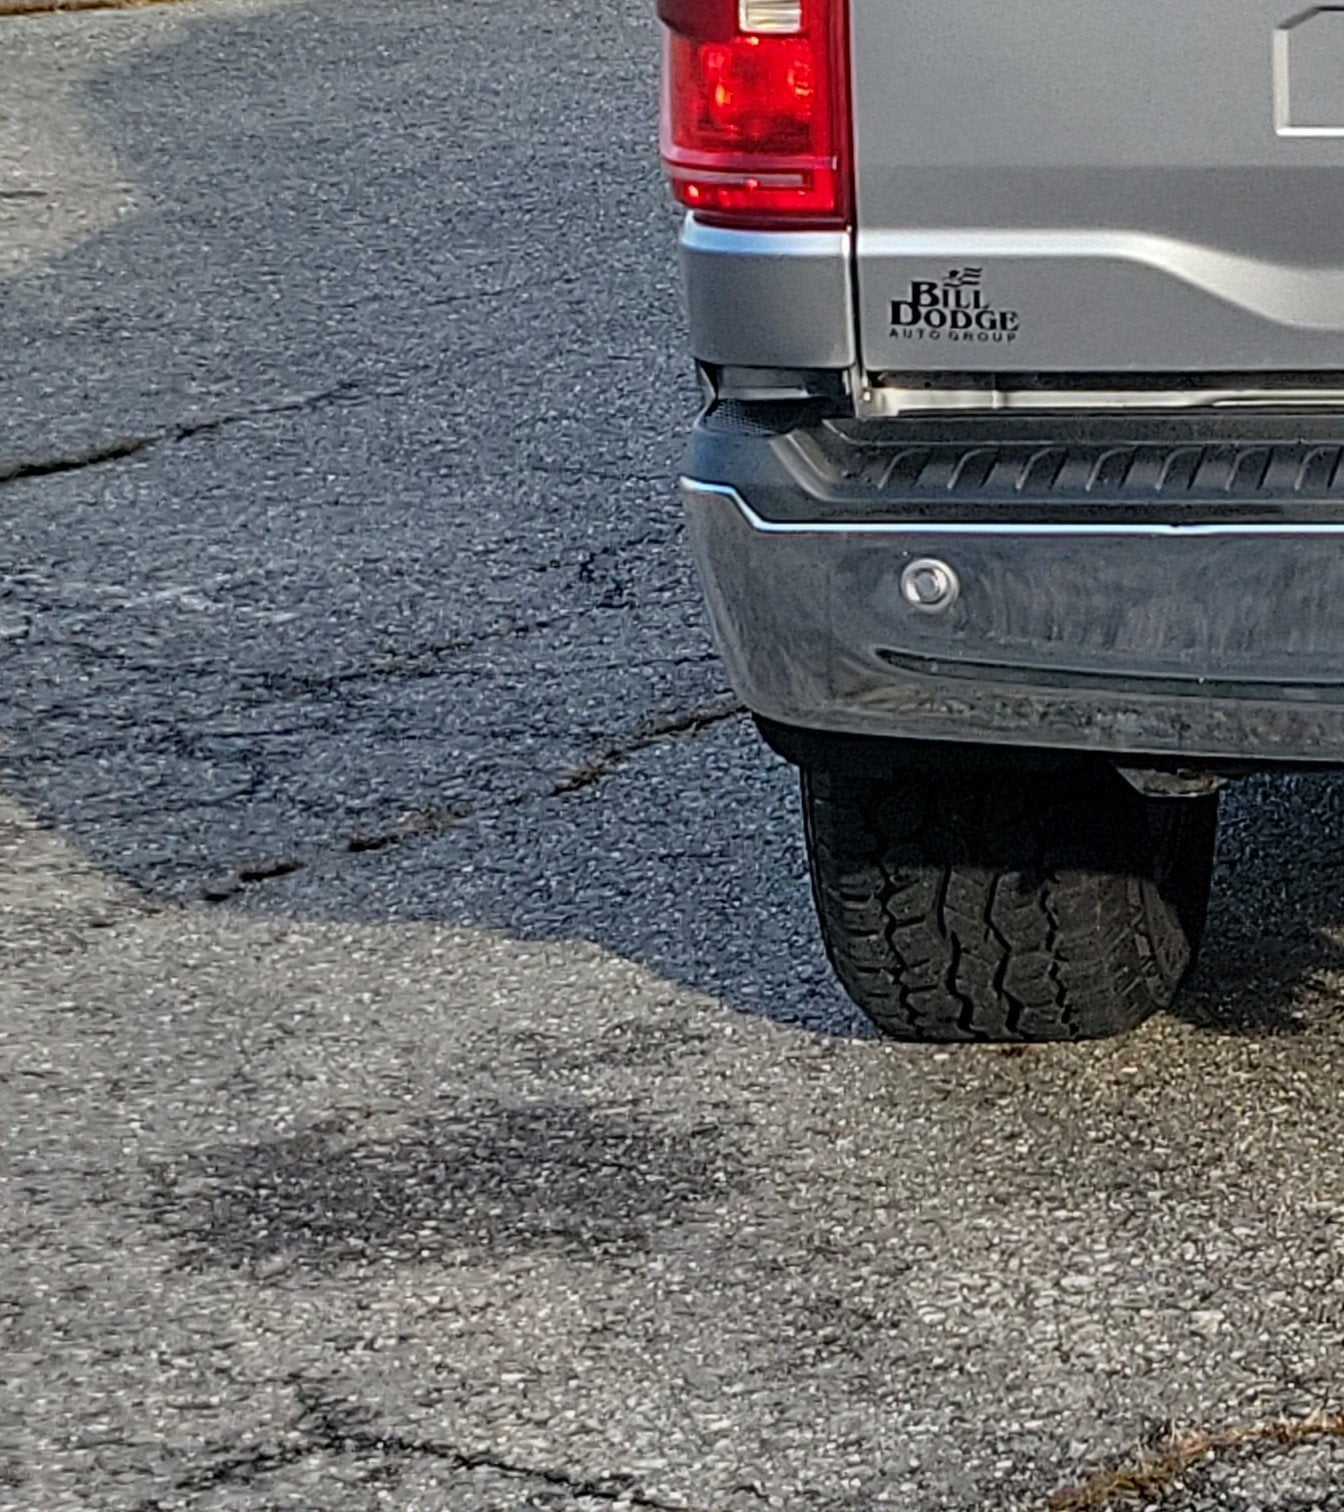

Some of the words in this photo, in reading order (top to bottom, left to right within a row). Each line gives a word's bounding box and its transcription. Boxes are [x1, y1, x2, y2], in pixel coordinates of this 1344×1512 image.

[911, 280, 990, 309] BILL
[890, 299, 1020, 332] DODGE
[889, 327, 941, 340] AUTO
[948, 330, 1017, 343] GROUP
